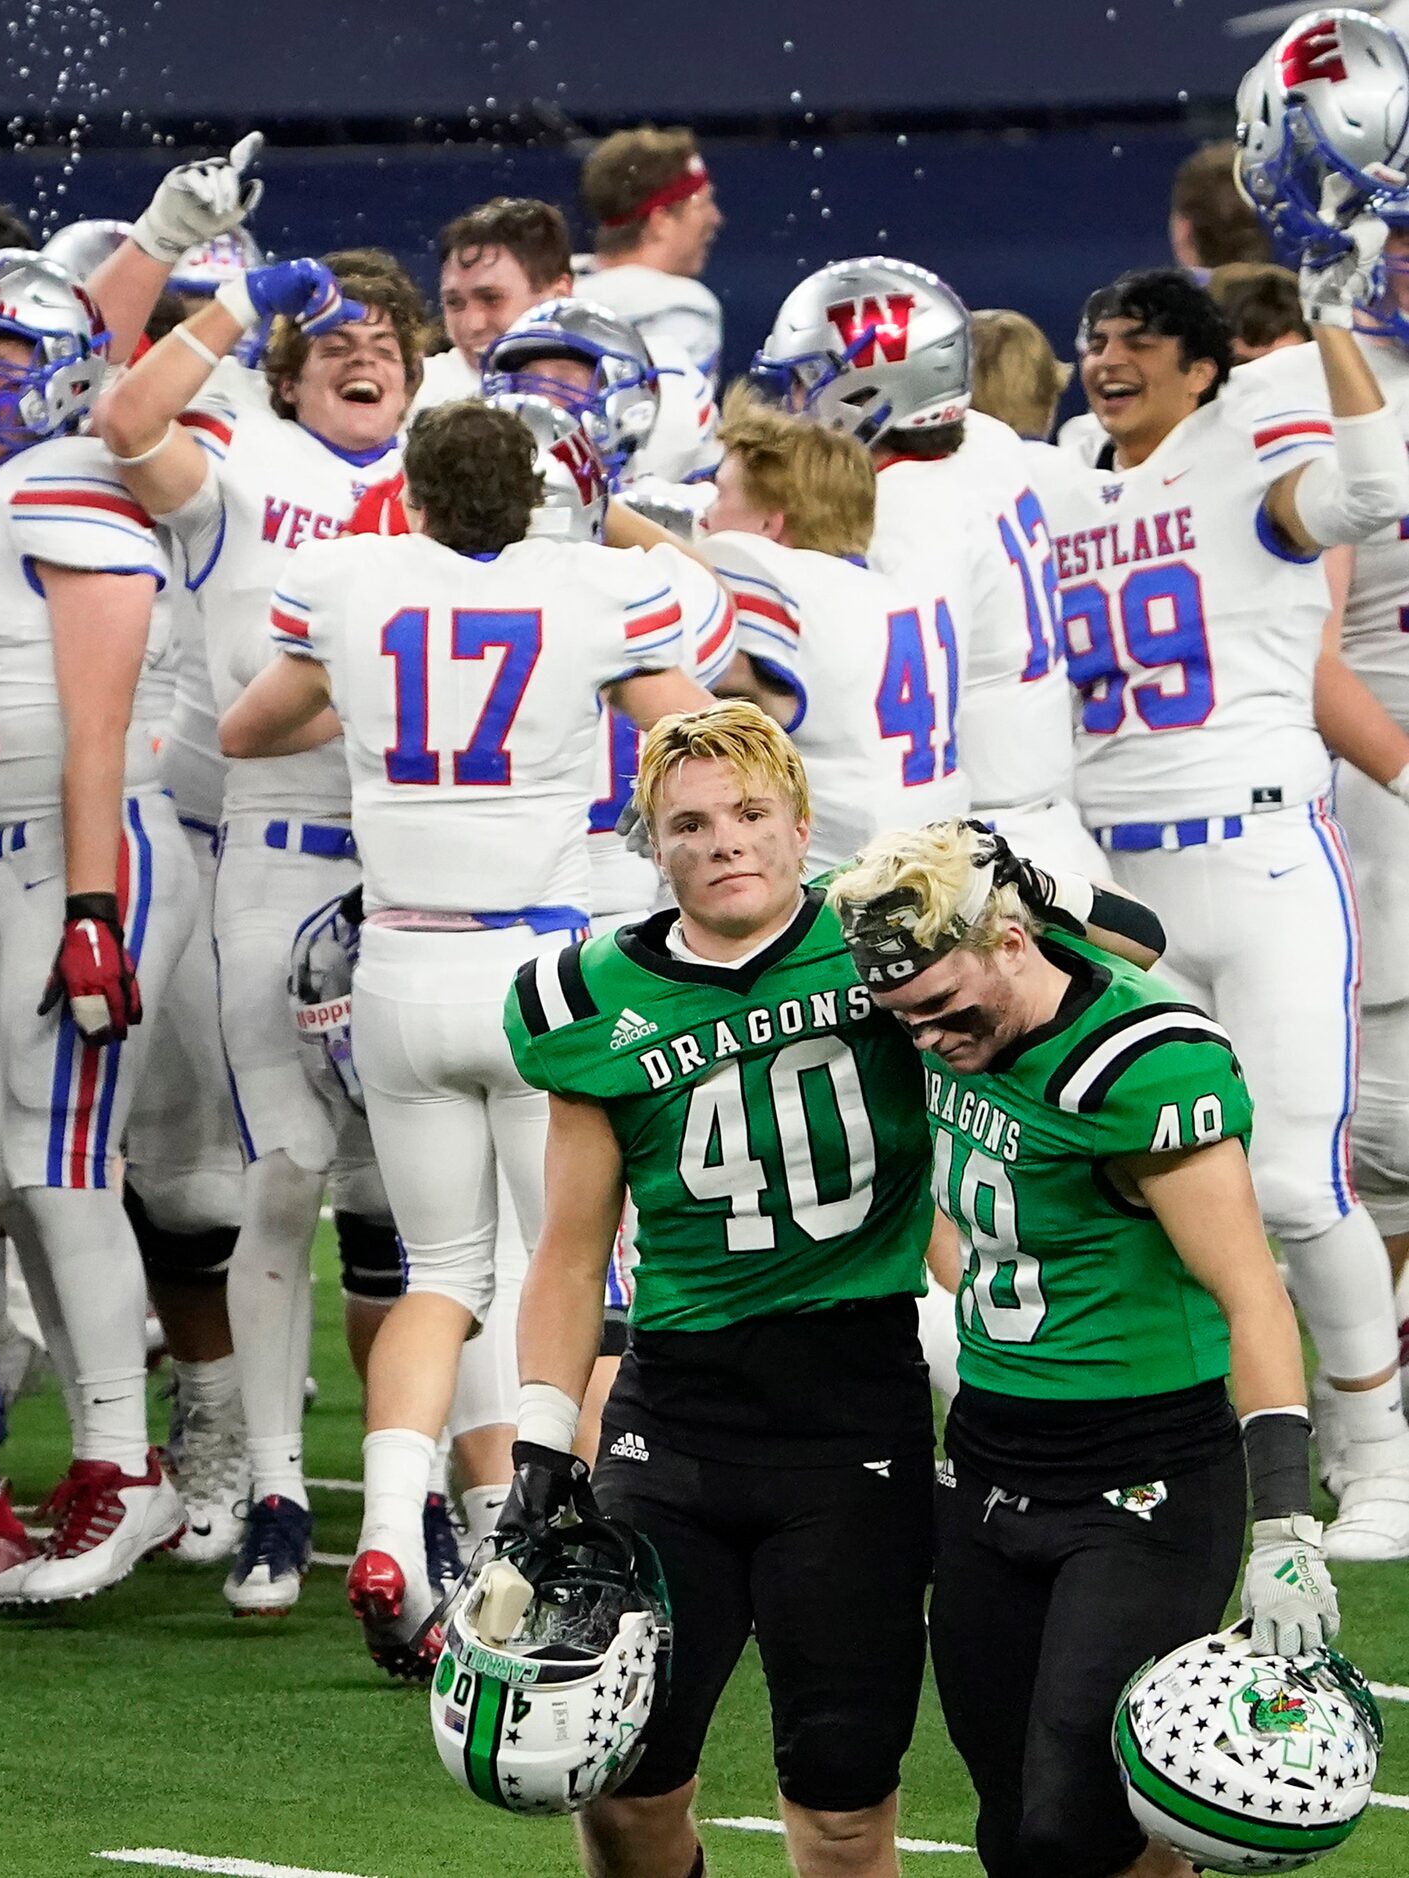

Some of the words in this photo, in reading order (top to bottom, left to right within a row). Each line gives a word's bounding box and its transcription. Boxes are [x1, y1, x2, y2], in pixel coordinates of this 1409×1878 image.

[826, 293, 915, 368] W
[1052, 506, 1196, 579] ESTLAKE
[380, 608, 543, 787] 17
[874, 596, 959, 787] 41
[610, 1020, 659, 1051] adidas
[638, 983, 873, 1091] DRAGONS
[678, 1034, 878, 1253] 40
[1148, 1092, 1225, 1153] 48
[929, 1125, 1049, 1345] 48
[610, 1443, 650, 1462] adidas
